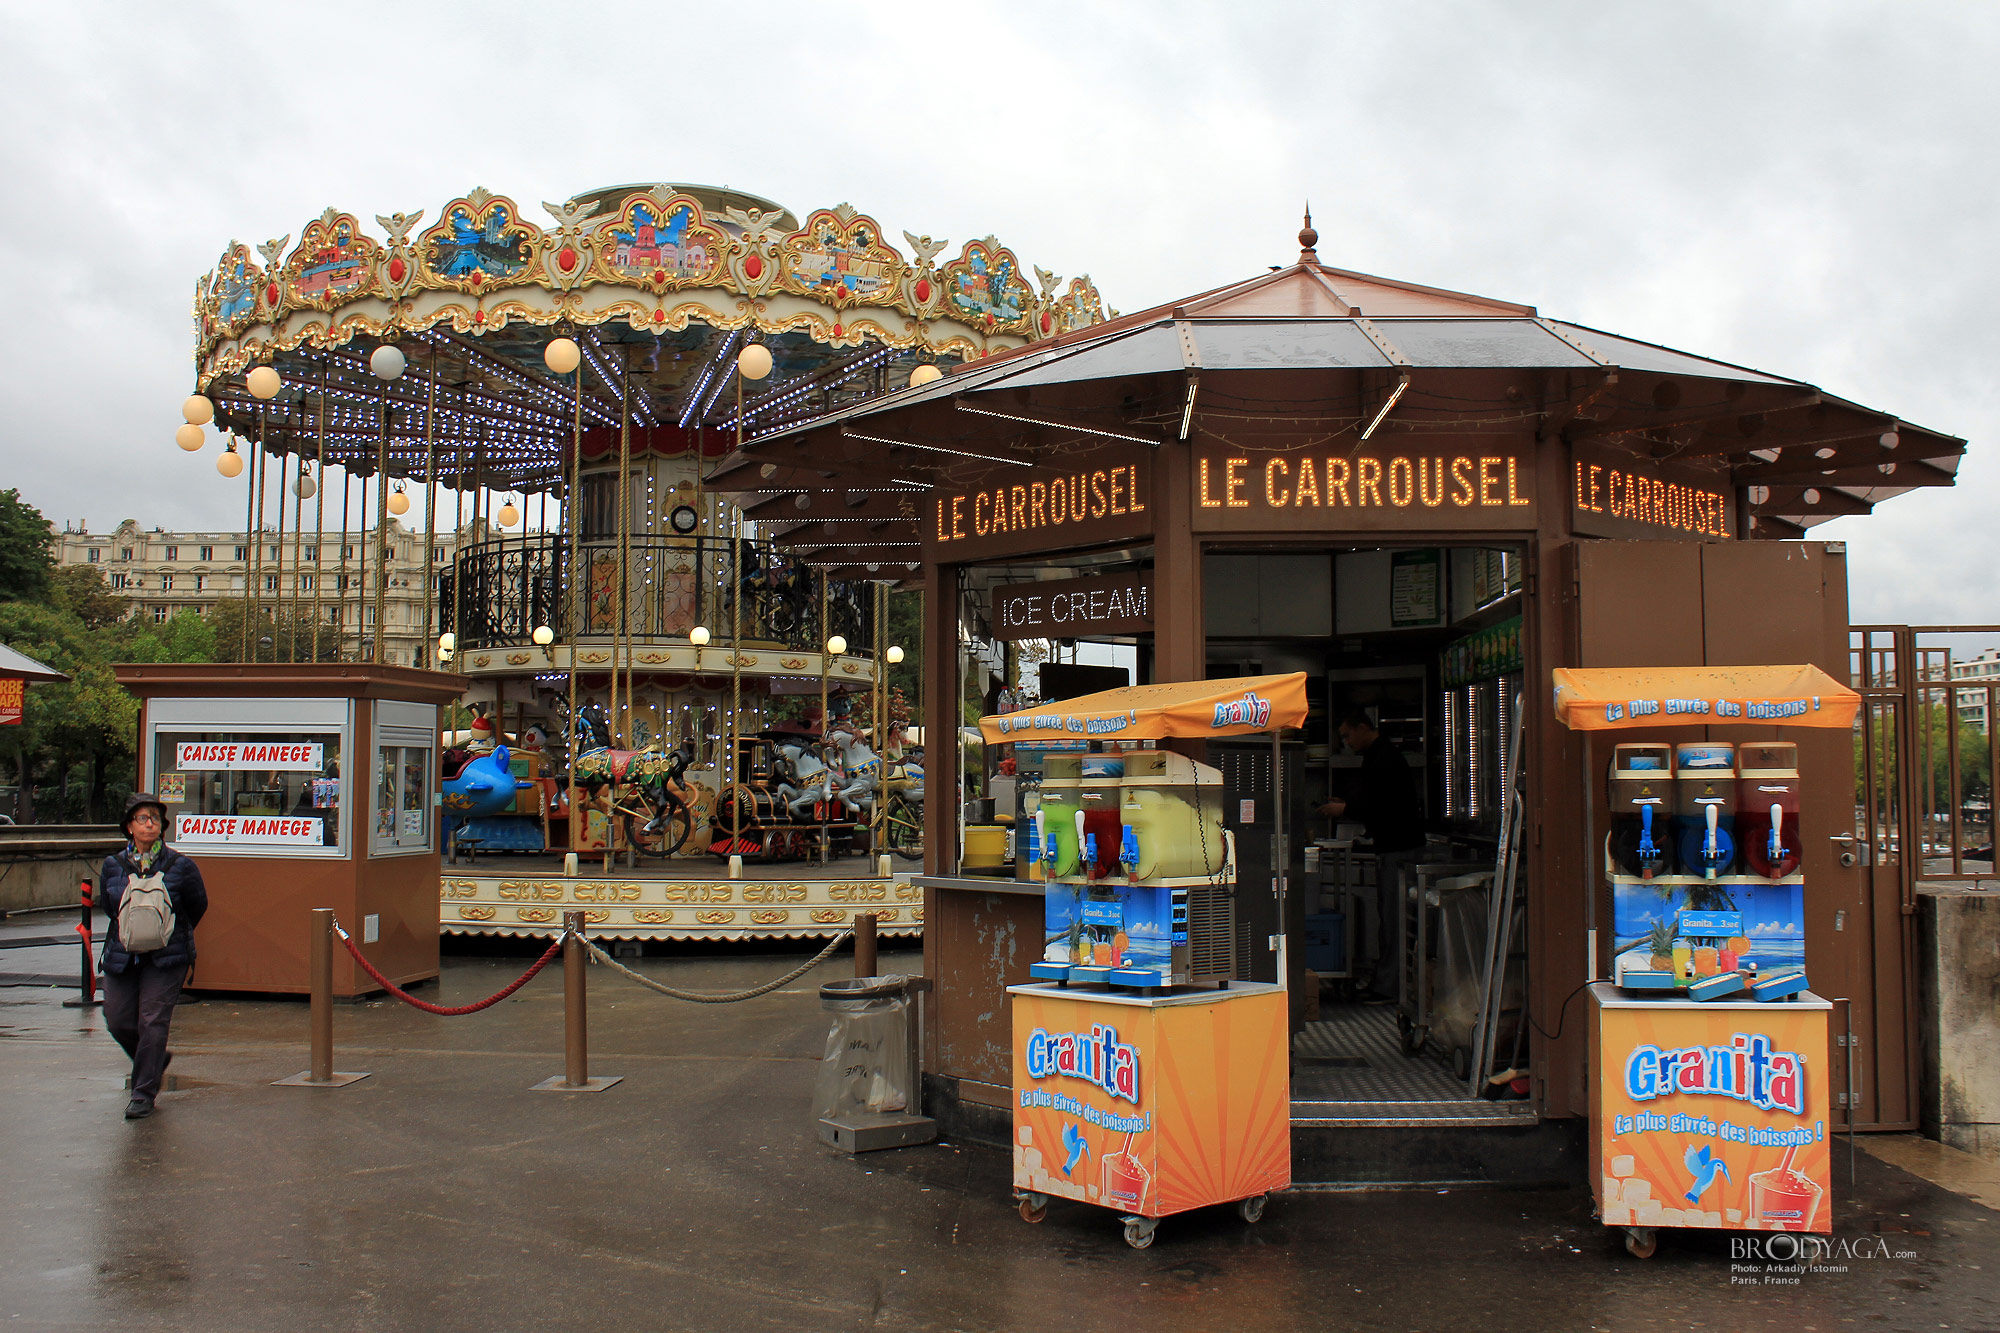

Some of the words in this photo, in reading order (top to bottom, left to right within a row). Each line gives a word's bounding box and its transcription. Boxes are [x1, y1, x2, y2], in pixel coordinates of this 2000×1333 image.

[1200, 457, 1249, 508] LE
[1265, 456, 1529, 508] CARROUSEL
[1576, 461, 1603, 513] LE
[1609, 469, 1732, 538] CARROUSEL
[937, 496, 966, 542] LE
[974, 464, 1146, 537] CARROUSEL
[1003, 596, 1042, 627] ICE
[1051, 586, 1147, 623] CREAM
[1012, 715, 1031, 732] plus
[1034, 714, 1063, 731] givrée
[1066, 715, 1084, 734] des
[1086, 715, 1128, 735] boissons
[1210, 692, 1271, 728] Granita
[1629, 699, 1660, 718] plus
[1665, 697, 1710, 716] givrée
[1715, 699, 1741, 717] des
[1746, 699, 1807, 720] boissons
[183, 745, 237, 763] CAISSE
[241, 745, 312, 764] MANEGE
[182, 818, 237, 836] CAISSE
[241, 818, 312, 837] MANEGE
[1682, 918, 1713, 928] Granita
[1033, 1087, 1051, 1108] plus
[1053, 1092, 1083, 1118] givrée
[1083, 1104, 1101, 1126] des
[1101, 1110, 1144, 1133] boissons
[1636, 1110, 1667, 1134] plus
[1670, 1113, 1717, 1136] givrée
[1719, 1121, 1747, 1143] des
[1749, 1126, 1814, 1147] boissons
